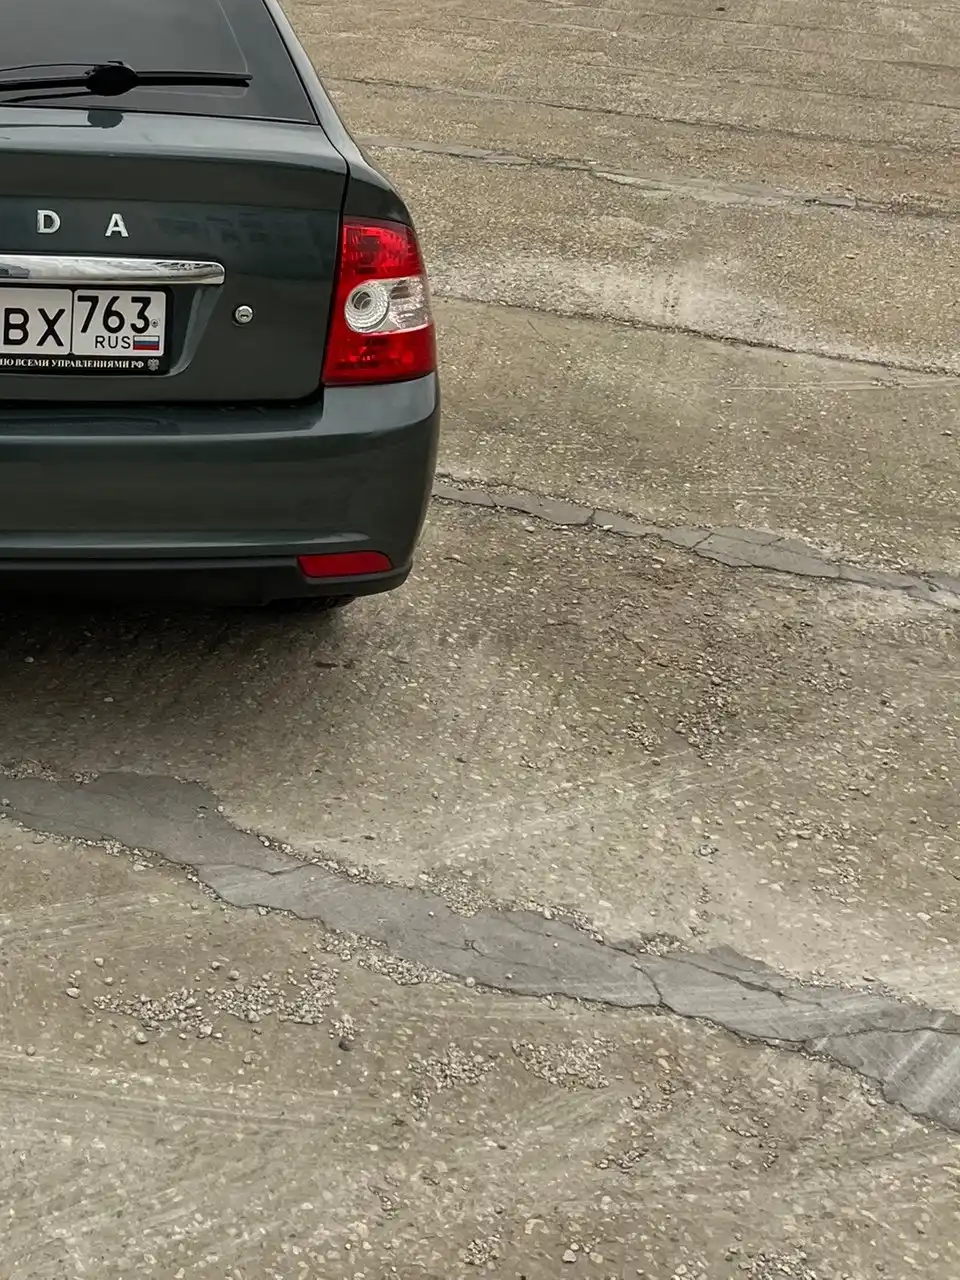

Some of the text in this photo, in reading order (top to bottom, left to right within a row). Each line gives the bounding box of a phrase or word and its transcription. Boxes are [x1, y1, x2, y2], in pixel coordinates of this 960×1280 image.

[77, 295, 152, 334] 763
[95, 335, 132, 350] RUS
[15, 358, 49, 368] ВСЕМИ
[51, 359, 130, 369] УПРАВЛЕНИЯМИ
[131, 360, 145, 369] РФ
